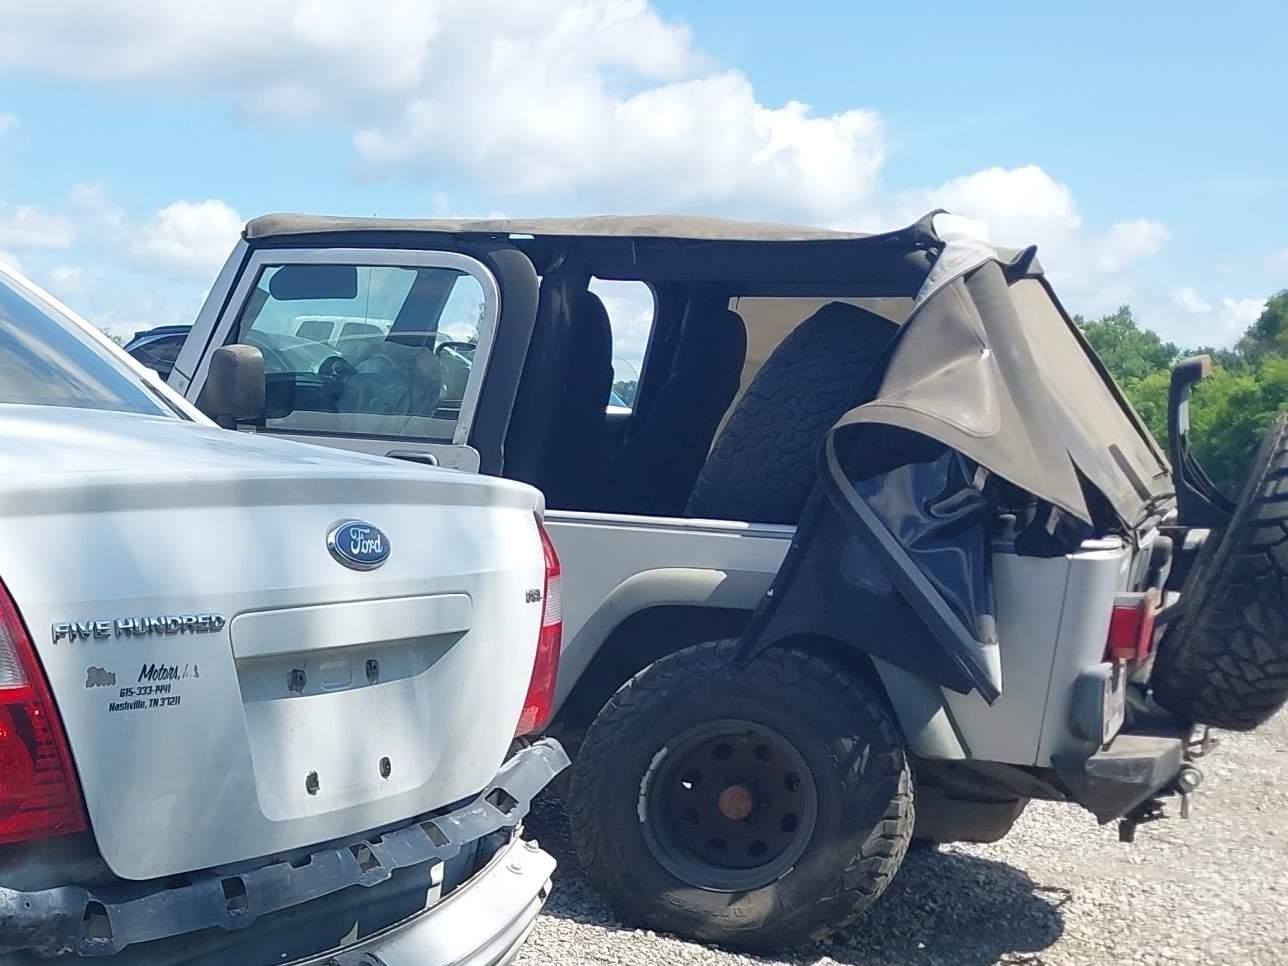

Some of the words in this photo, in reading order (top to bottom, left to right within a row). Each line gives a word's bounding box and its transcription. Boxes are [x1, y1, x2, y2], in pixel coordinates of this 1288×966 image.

[350, 527, 383, 554] Ford
[52, 620, 111, 645] FIVE
[114, 613, 226, 639] HUNDRED
[108, 700, 148, 712] Nashville,
[149, 698, 159, 708] TN
[159, 696, 181, 707] 37211
